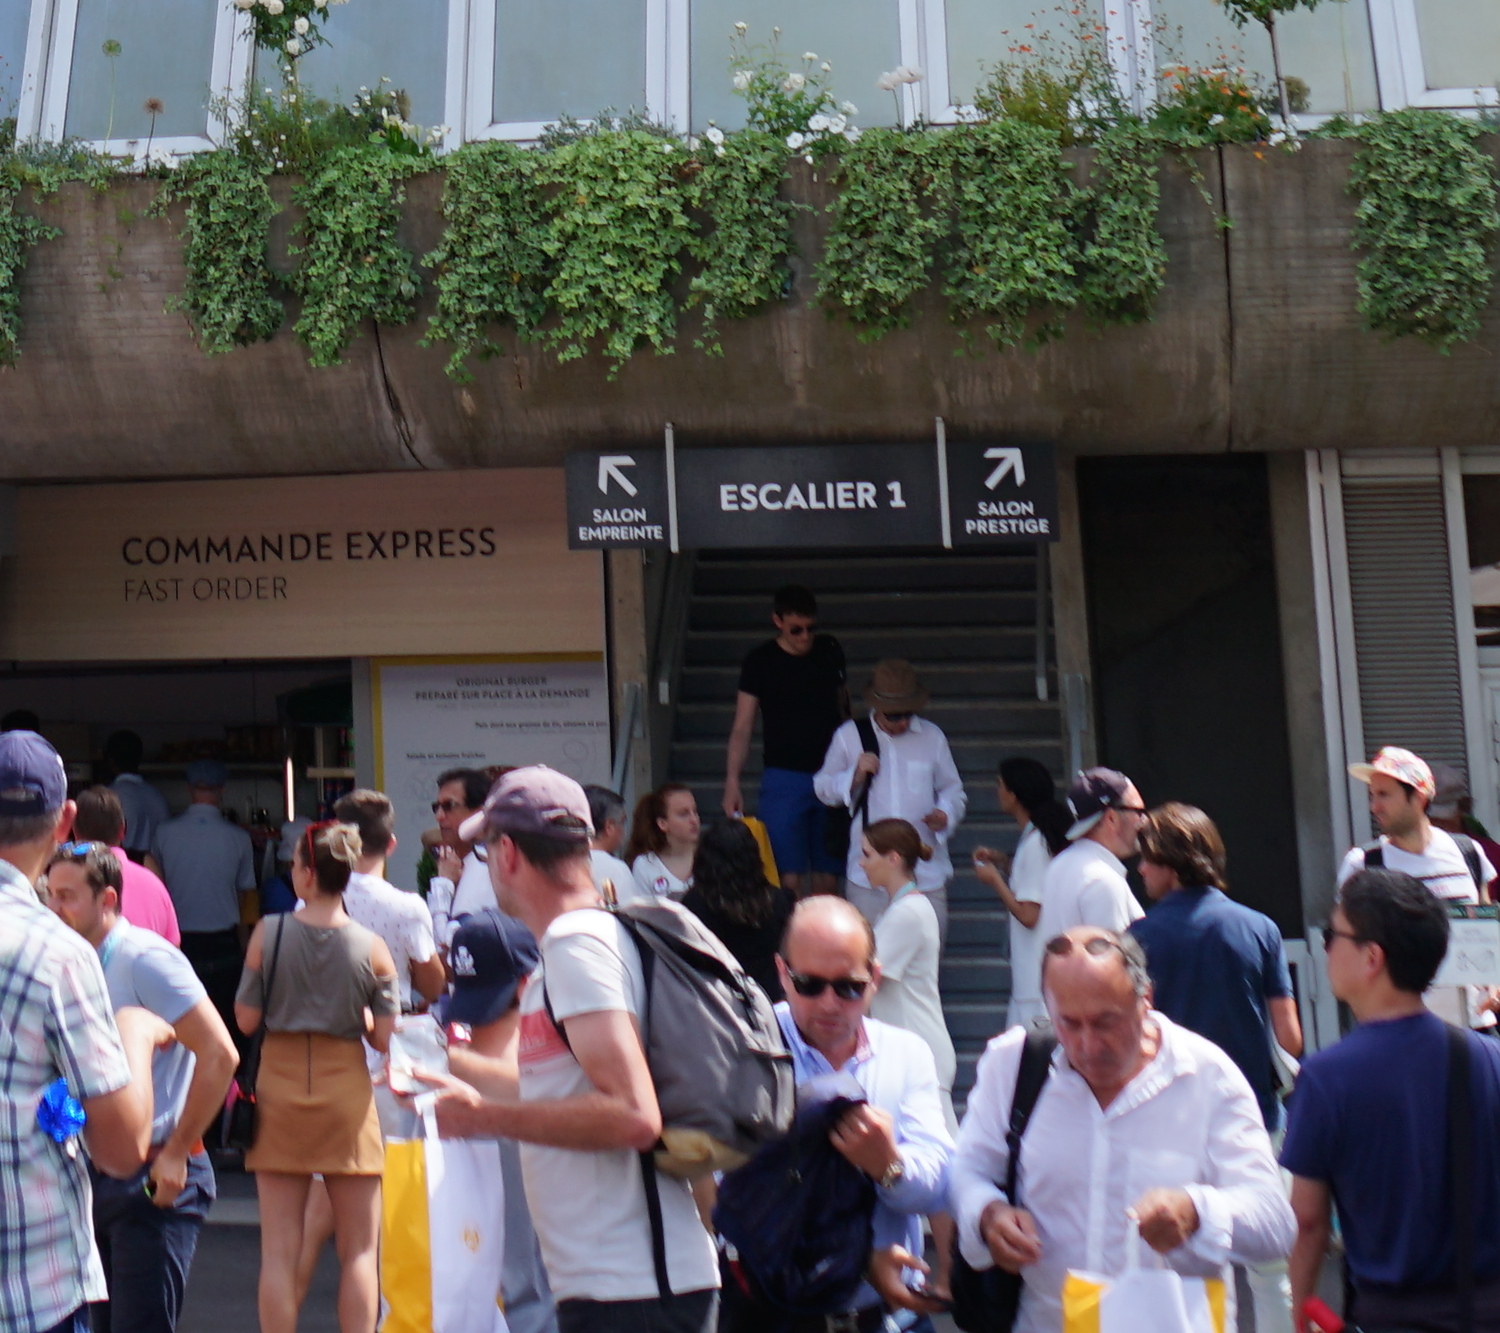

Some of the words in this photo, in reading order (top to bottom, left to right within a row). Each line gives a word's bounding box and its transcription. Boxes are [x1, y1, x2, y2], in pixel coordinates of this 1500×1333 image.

[720, 482, 877, 512] ESCALIER
[889, 481, 906, 509] 1
[592, 507, 646, 524] SALON
[978, 501, 1035, 518] SALON
[578, 525, 664, 542] EMPREINTE
[965, 517, 1051, 535] PRESTIGE
[122, 531, 333, 566] COMMANDE
[346, 527, 497, 560] EXPRESS
[124, 578, 183, 603] FAST
[193, 576, 288, 602] ORDER
[461, 690, 480, 700] SUR
[482, 689, 513, 700] PLACE
[525, 689, 537, 699] LA
[539, 688, 591, 699] DEMANDE
